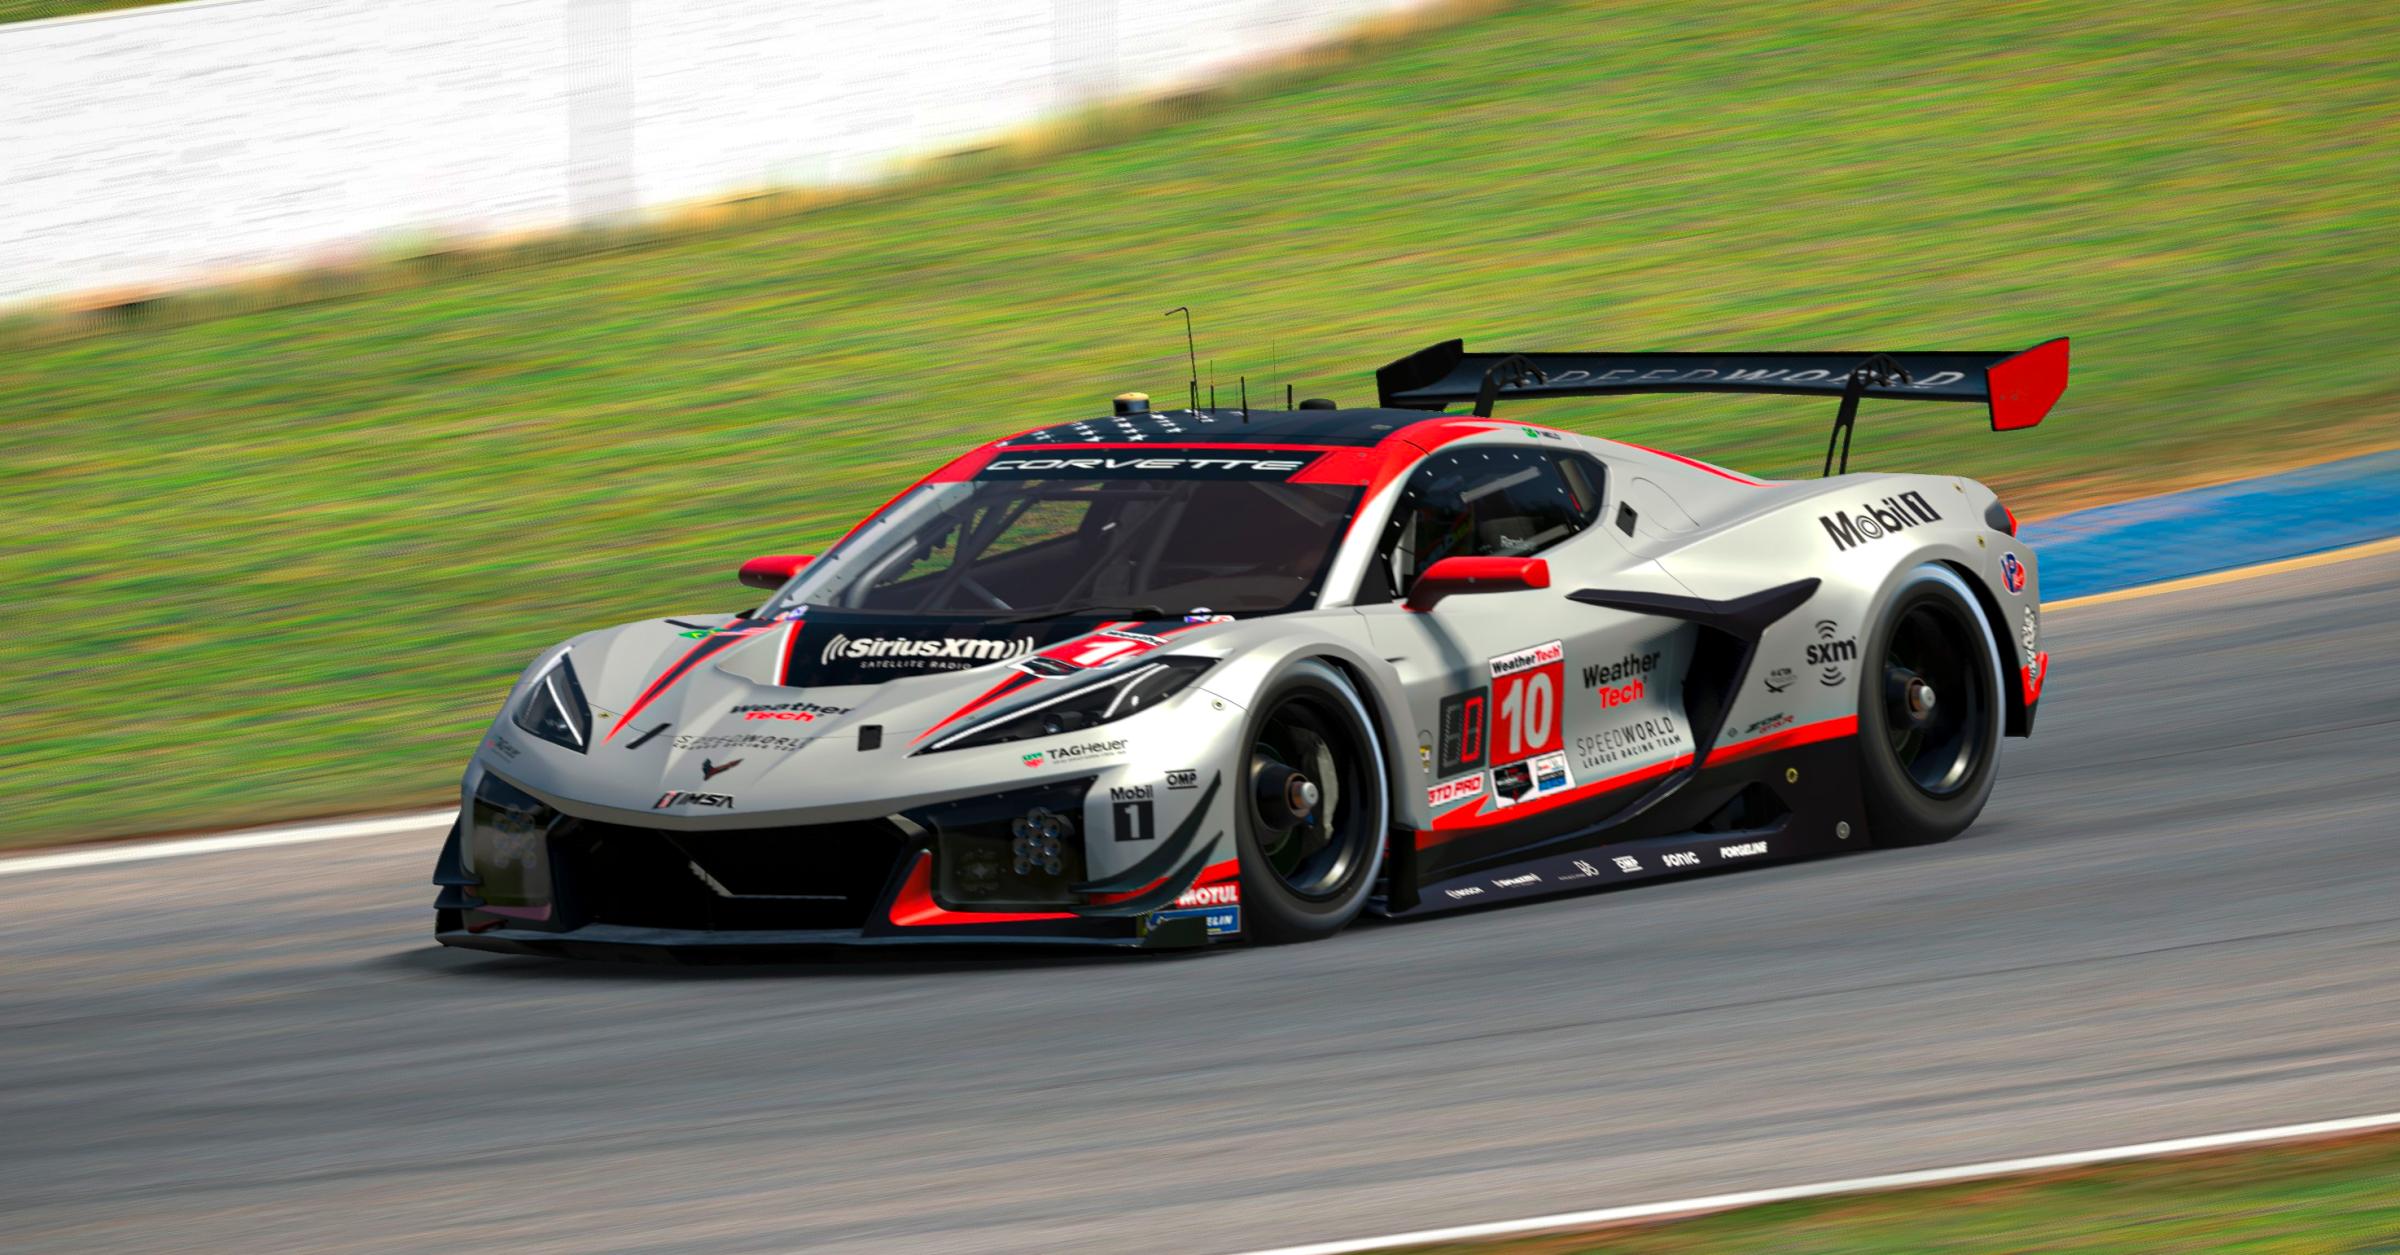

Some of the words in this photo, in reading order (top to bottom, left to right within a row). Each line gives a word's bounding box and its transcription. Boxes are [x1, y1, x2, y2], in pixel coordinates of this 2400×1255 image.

[1512, 368, 1965, 386] PEEDWORD
[985, 458, 1304, 471] CORVETTE
[1818, 496, 1920, 552] Mobil
[860, 659, 925, 669] SATELLITE
[929, 660, 972, 671] RADIO
[1492, 646, 1561, 674] WeatherTech
[1582, 651, 1661, 689] Weather
[1599, 678, 1645, 709] Tech
[729, 702, 855, 716] Weather
[744, 711, 815, 722] Tech
[1501, 672, 1554, 755] 10
[1575, 716, 1675, 757] SPEEDWORLD
[1582, 750, 1618, 769] LEAGUE
[1621, 741, 1655, 759] RACING
[1656, 734, 1682, 748] TEAM
[1166, 772, 1198, 787] OMP
[1454, 776, 1481, 797] PRO
[1110, 785, 1154, 800] Mobil
[1719, 841, 1769, 859] FORGELINE
[1179, 885, 1238, 906] MOTUL
[1205, 915, 1234, 927] ELIN
